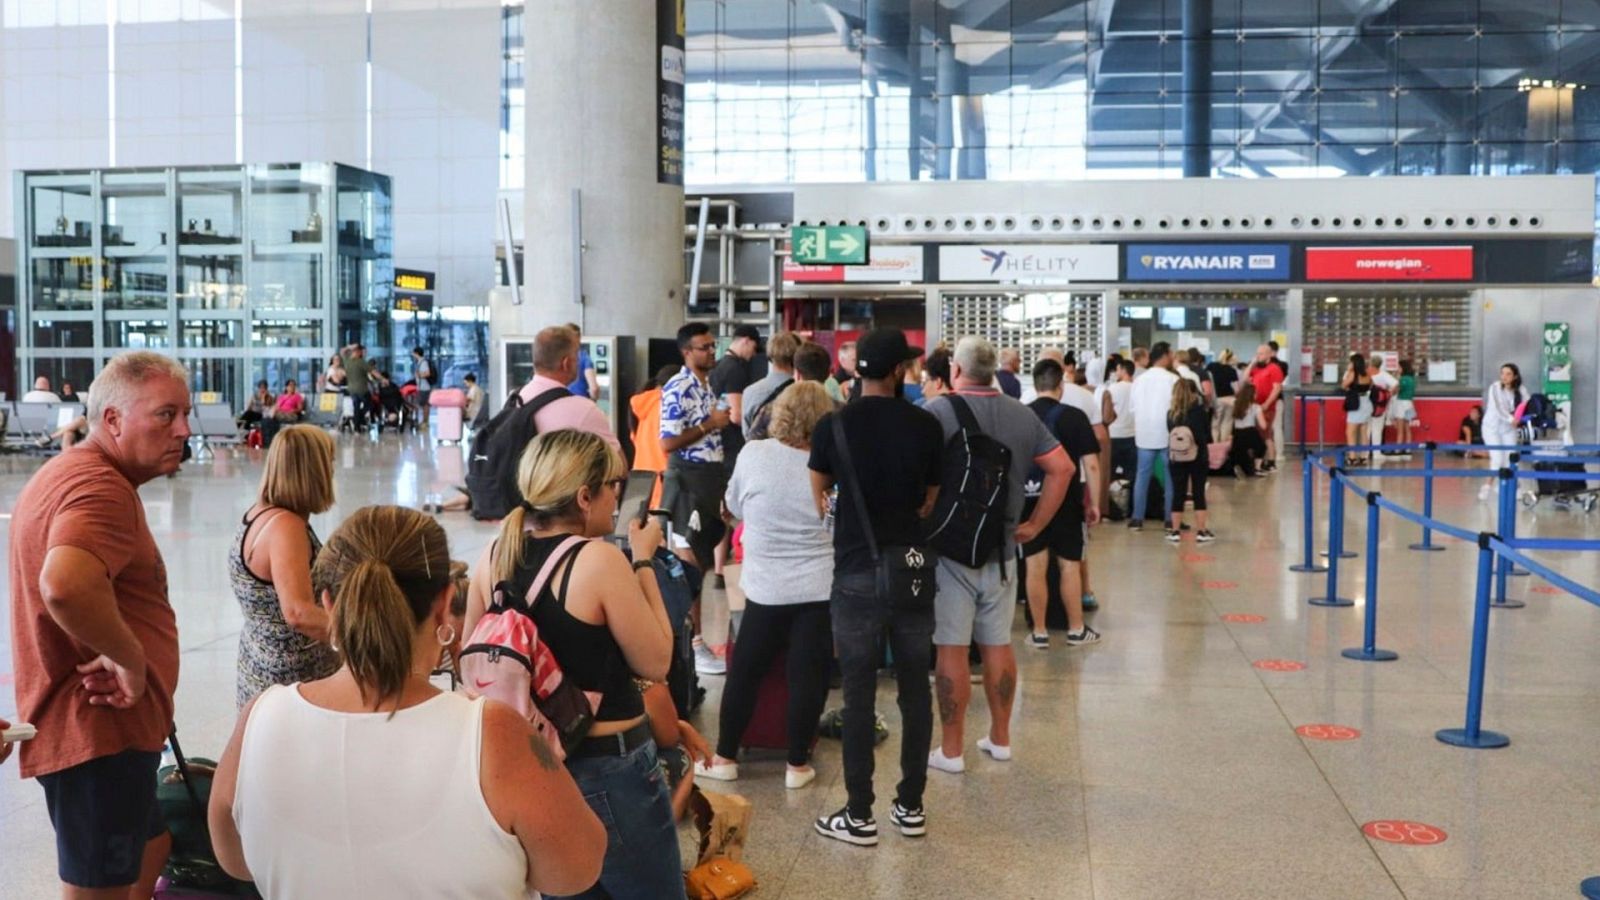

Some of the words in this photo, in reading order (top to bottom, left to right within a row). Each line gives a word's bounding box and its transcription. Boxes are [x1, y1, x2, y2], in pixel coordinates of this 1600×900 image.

[1153, 255, 1243, 270] RYANAIR
[1356, 257, 1423, 270] norwegian
[1544, 345, 1568, 355] DEA
